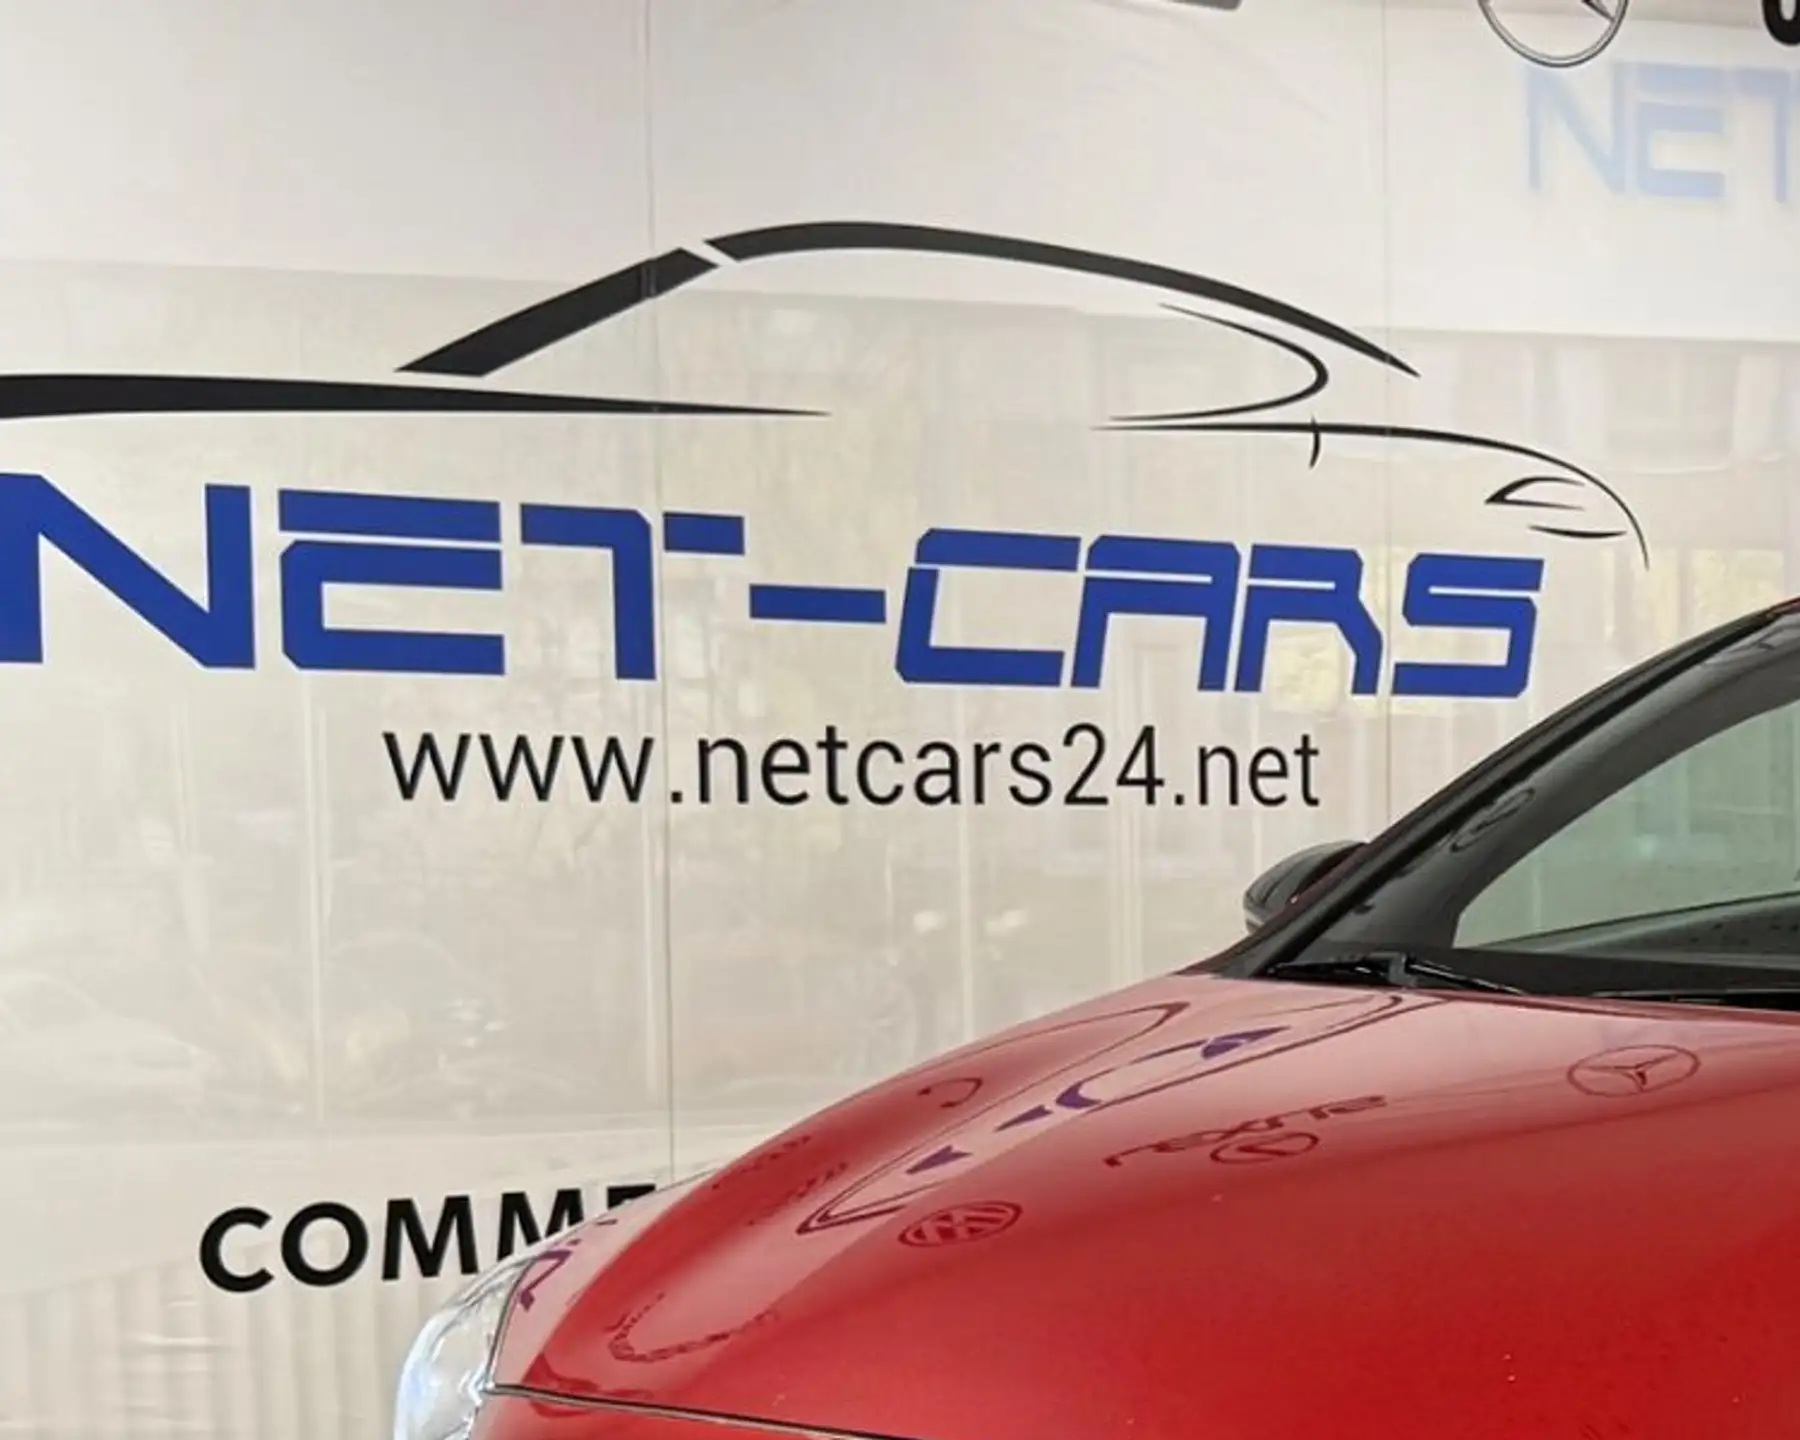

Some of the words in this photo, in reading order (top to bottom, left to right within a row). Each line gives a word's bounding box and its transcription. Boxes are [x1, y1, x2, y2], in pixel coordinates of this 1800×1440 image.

[0, 472, 1545, 698] NET-CARS
[382, 722, 1321, 807] www.netcars24.net
[199, 1183, 657, 1294] COMM
